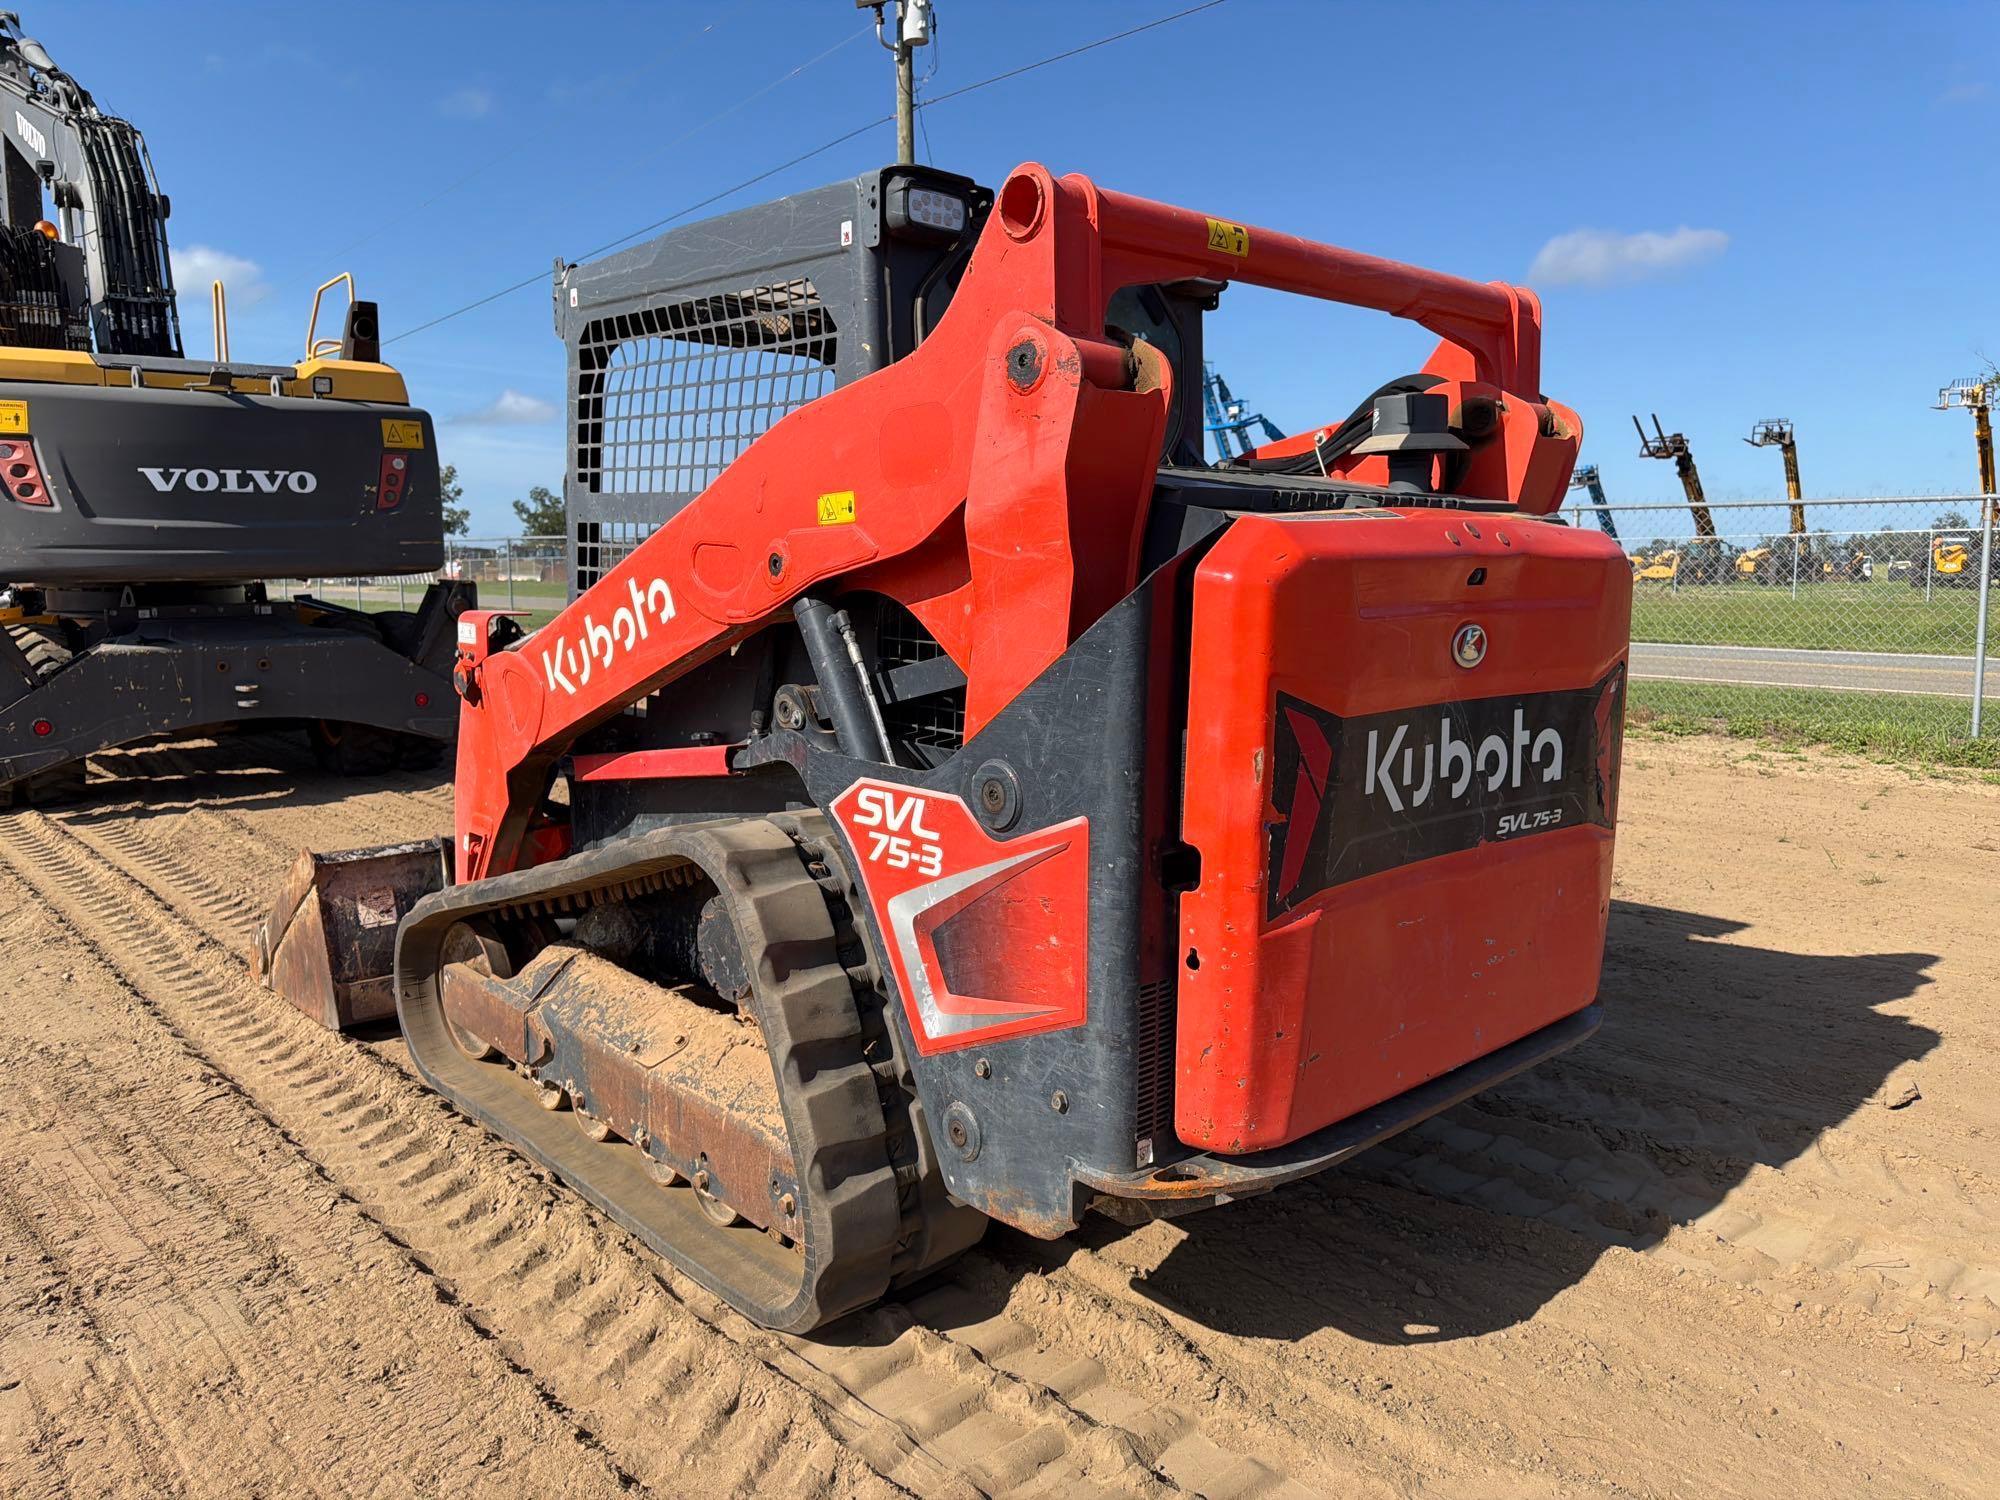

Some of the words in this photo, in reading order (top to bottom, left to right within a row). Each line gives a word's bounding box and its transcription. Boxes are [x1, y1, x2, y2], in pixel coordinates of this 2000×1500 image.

[15, 110, 46, 159] VOLVO
[137, 467, 317, 494] VOLVO
[542, 577, 676, 695] Kubota
[1364, 708, 1563, 811] Kubota
[853, 788, 940, 841] SVL
[868, 831, 943, 877] 75-3
